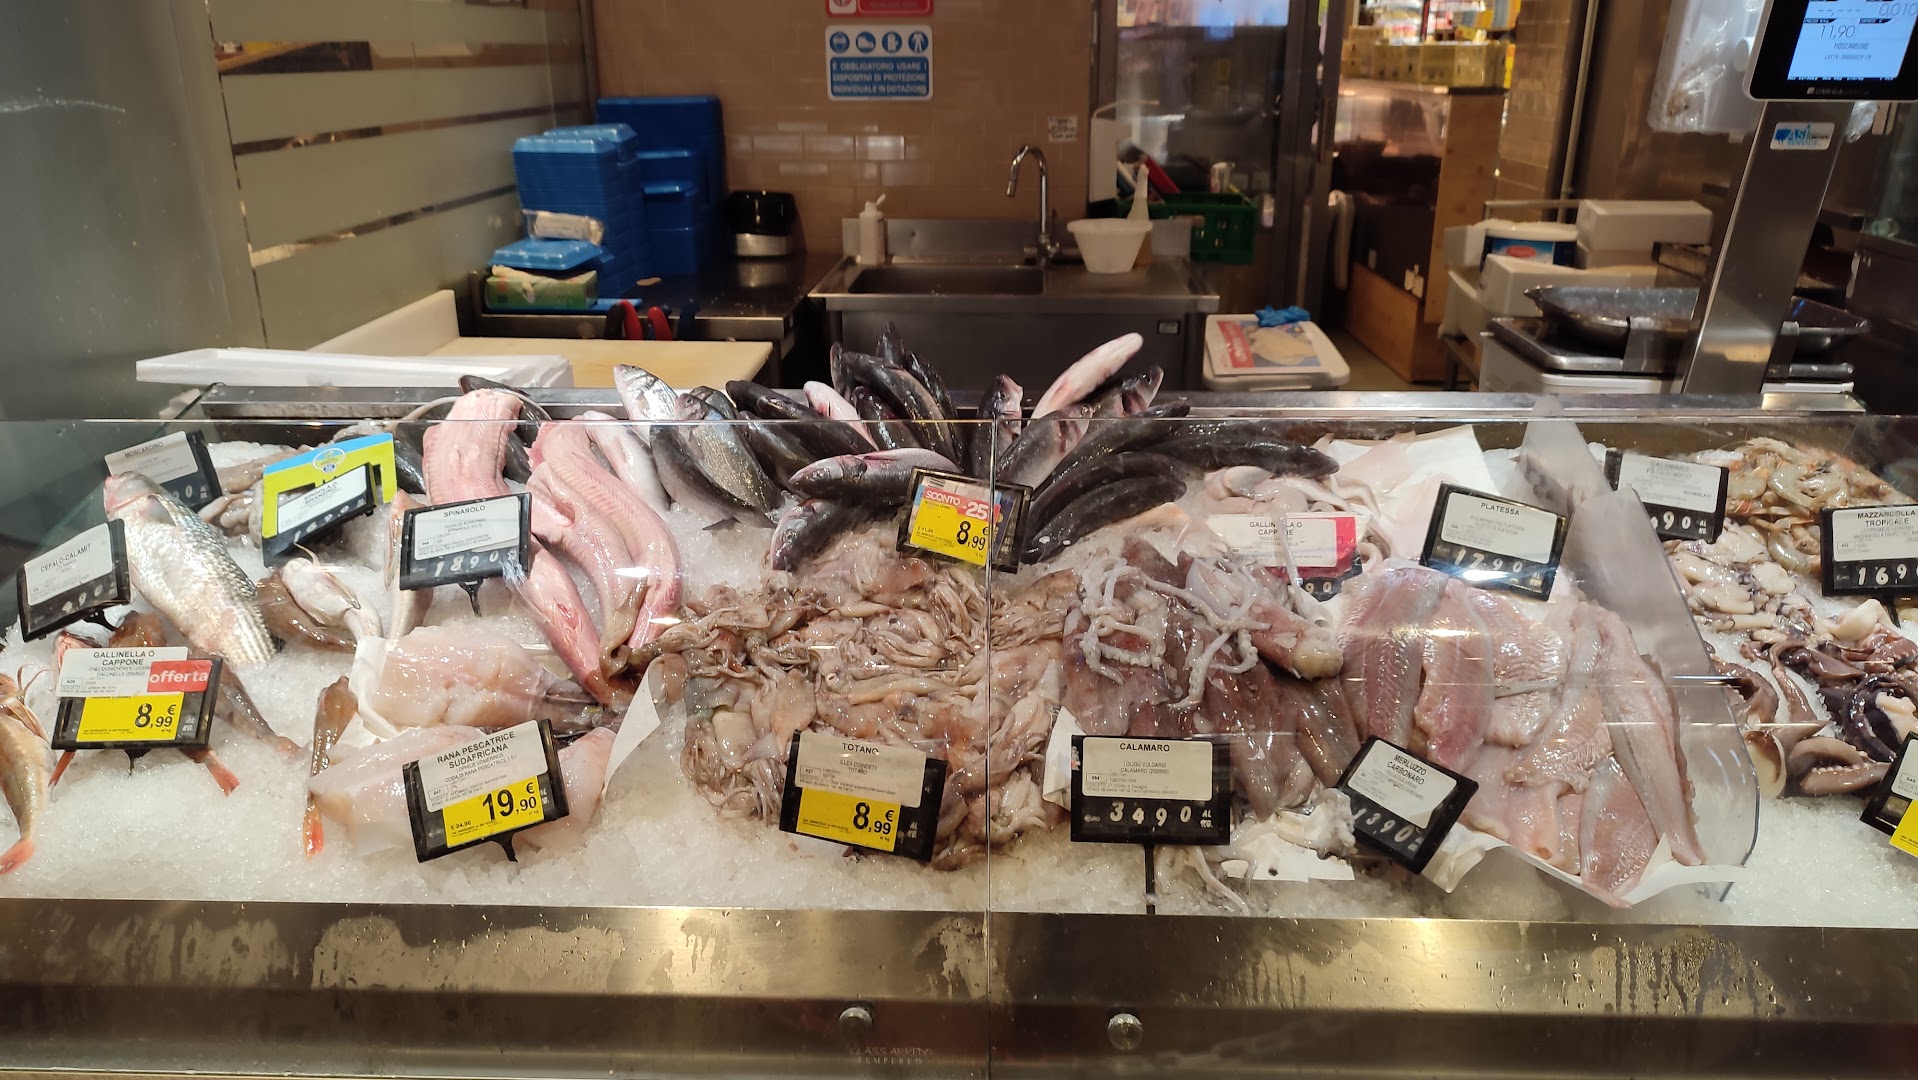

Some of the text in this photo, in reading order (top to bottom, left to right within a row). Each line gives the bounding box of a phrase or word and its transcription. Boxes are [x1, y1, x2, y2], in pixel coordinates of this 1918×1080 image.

[1820, 25, 1856, 39] 11,90
[840, 62, 894, 70] OBBLIGATORIO
[896, 62, 920, 70] USARE
[833, 73, 926, 82] DISPOSITIVI DI PROTEZIONE
[833, 84, 877, 93] INDIVIDUALE
[879, 84, 886, 92] IN
[124, 441, 164, 458] MOSCARDINO
[925, 490, 961, 506] SCONTO
[443, 505, 486, 518] SPINAROLO
[1480, 502, 1520, 516] PLATESSA
[956, 521, 987, 551] 8,99
[40, 543, 92, 573] CEFALO-CALAMIT
[93, 650, 146, 659] GALLINELLA
[102, 658, 144, 666] CAPPONE
[150, 669, 209, 684] offerta
[135, 703, 173, 729] 8,99
[167, 704, 176, 715] €
[437, 731, 516, 764] RANA PESCATRICE
[842, 742, 880, 755] TOTANO
[1119, 742, 1171, 752] CALAMARO
[449, 743, 509, 769] SUDAFRICANA
[1393, 754, 1427, 776] MERLUZZO
[1387, 762, 1425, 785] CARBONARO
[525, 782, 535, 794] €
[482, 789, 537, 822] 19,90
[853, 802, 892, 835] 8,99
[885, 809, 895, 822] €
[1202, 809, 1212, 818] AL
